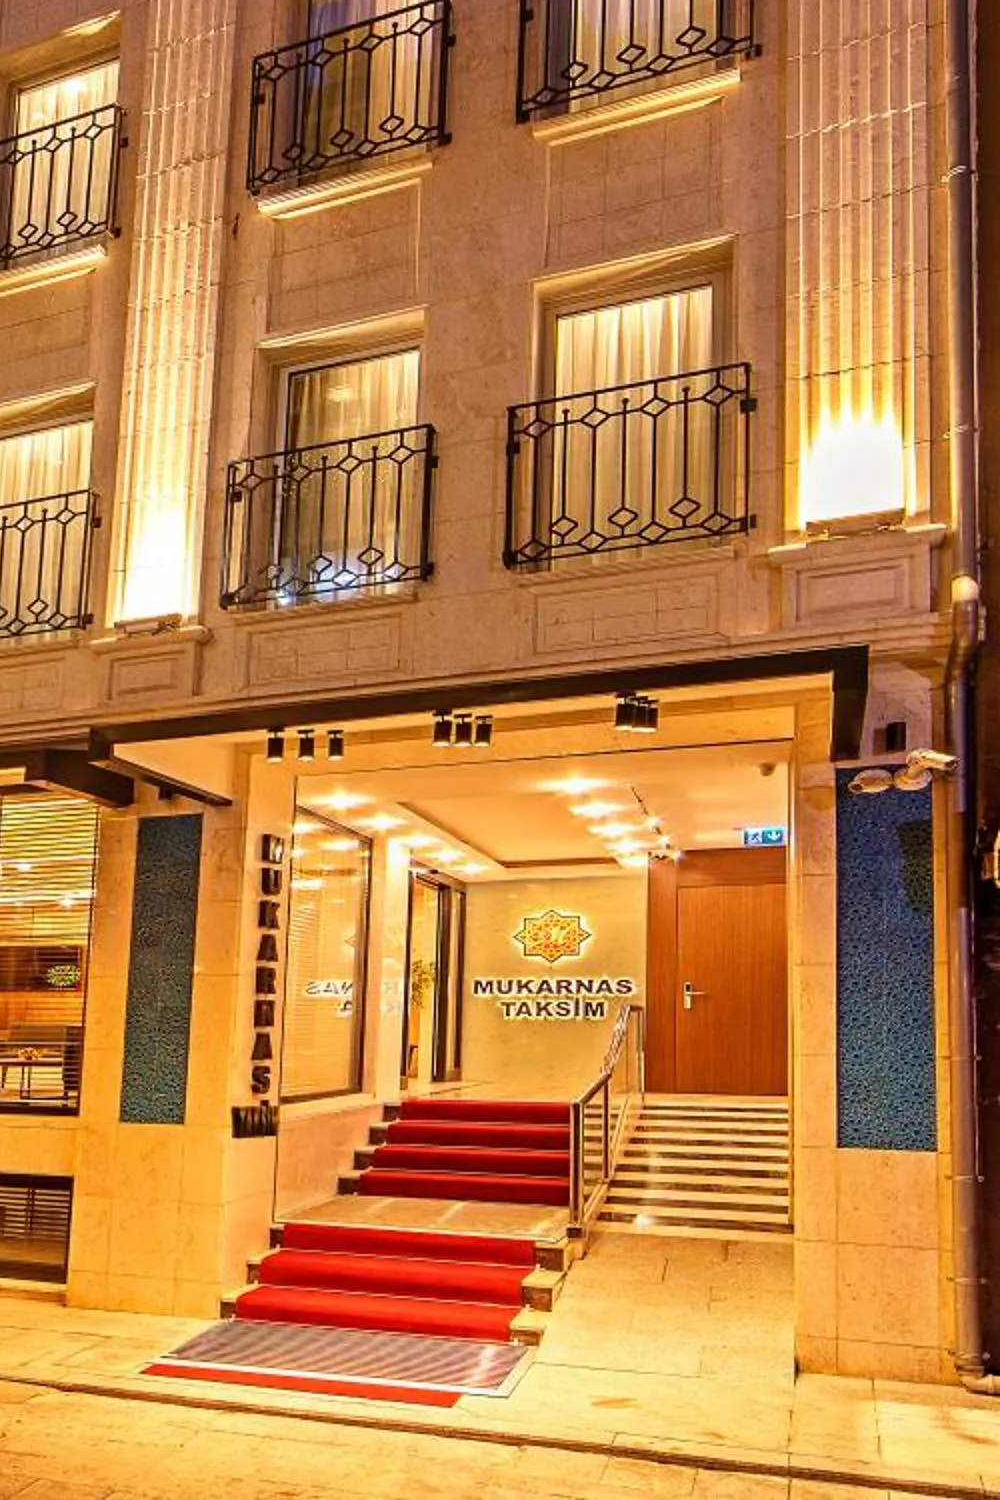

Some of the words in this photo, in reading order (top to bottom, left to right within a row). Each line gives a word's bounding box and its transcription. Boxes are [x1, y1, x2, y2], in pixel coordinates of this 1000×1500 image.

[251, 833, 285, 1095] MUKARNAS
[473, 979, 633, 995] MUKARNAS
[501, 998, 605, 1017] TAKSİM
